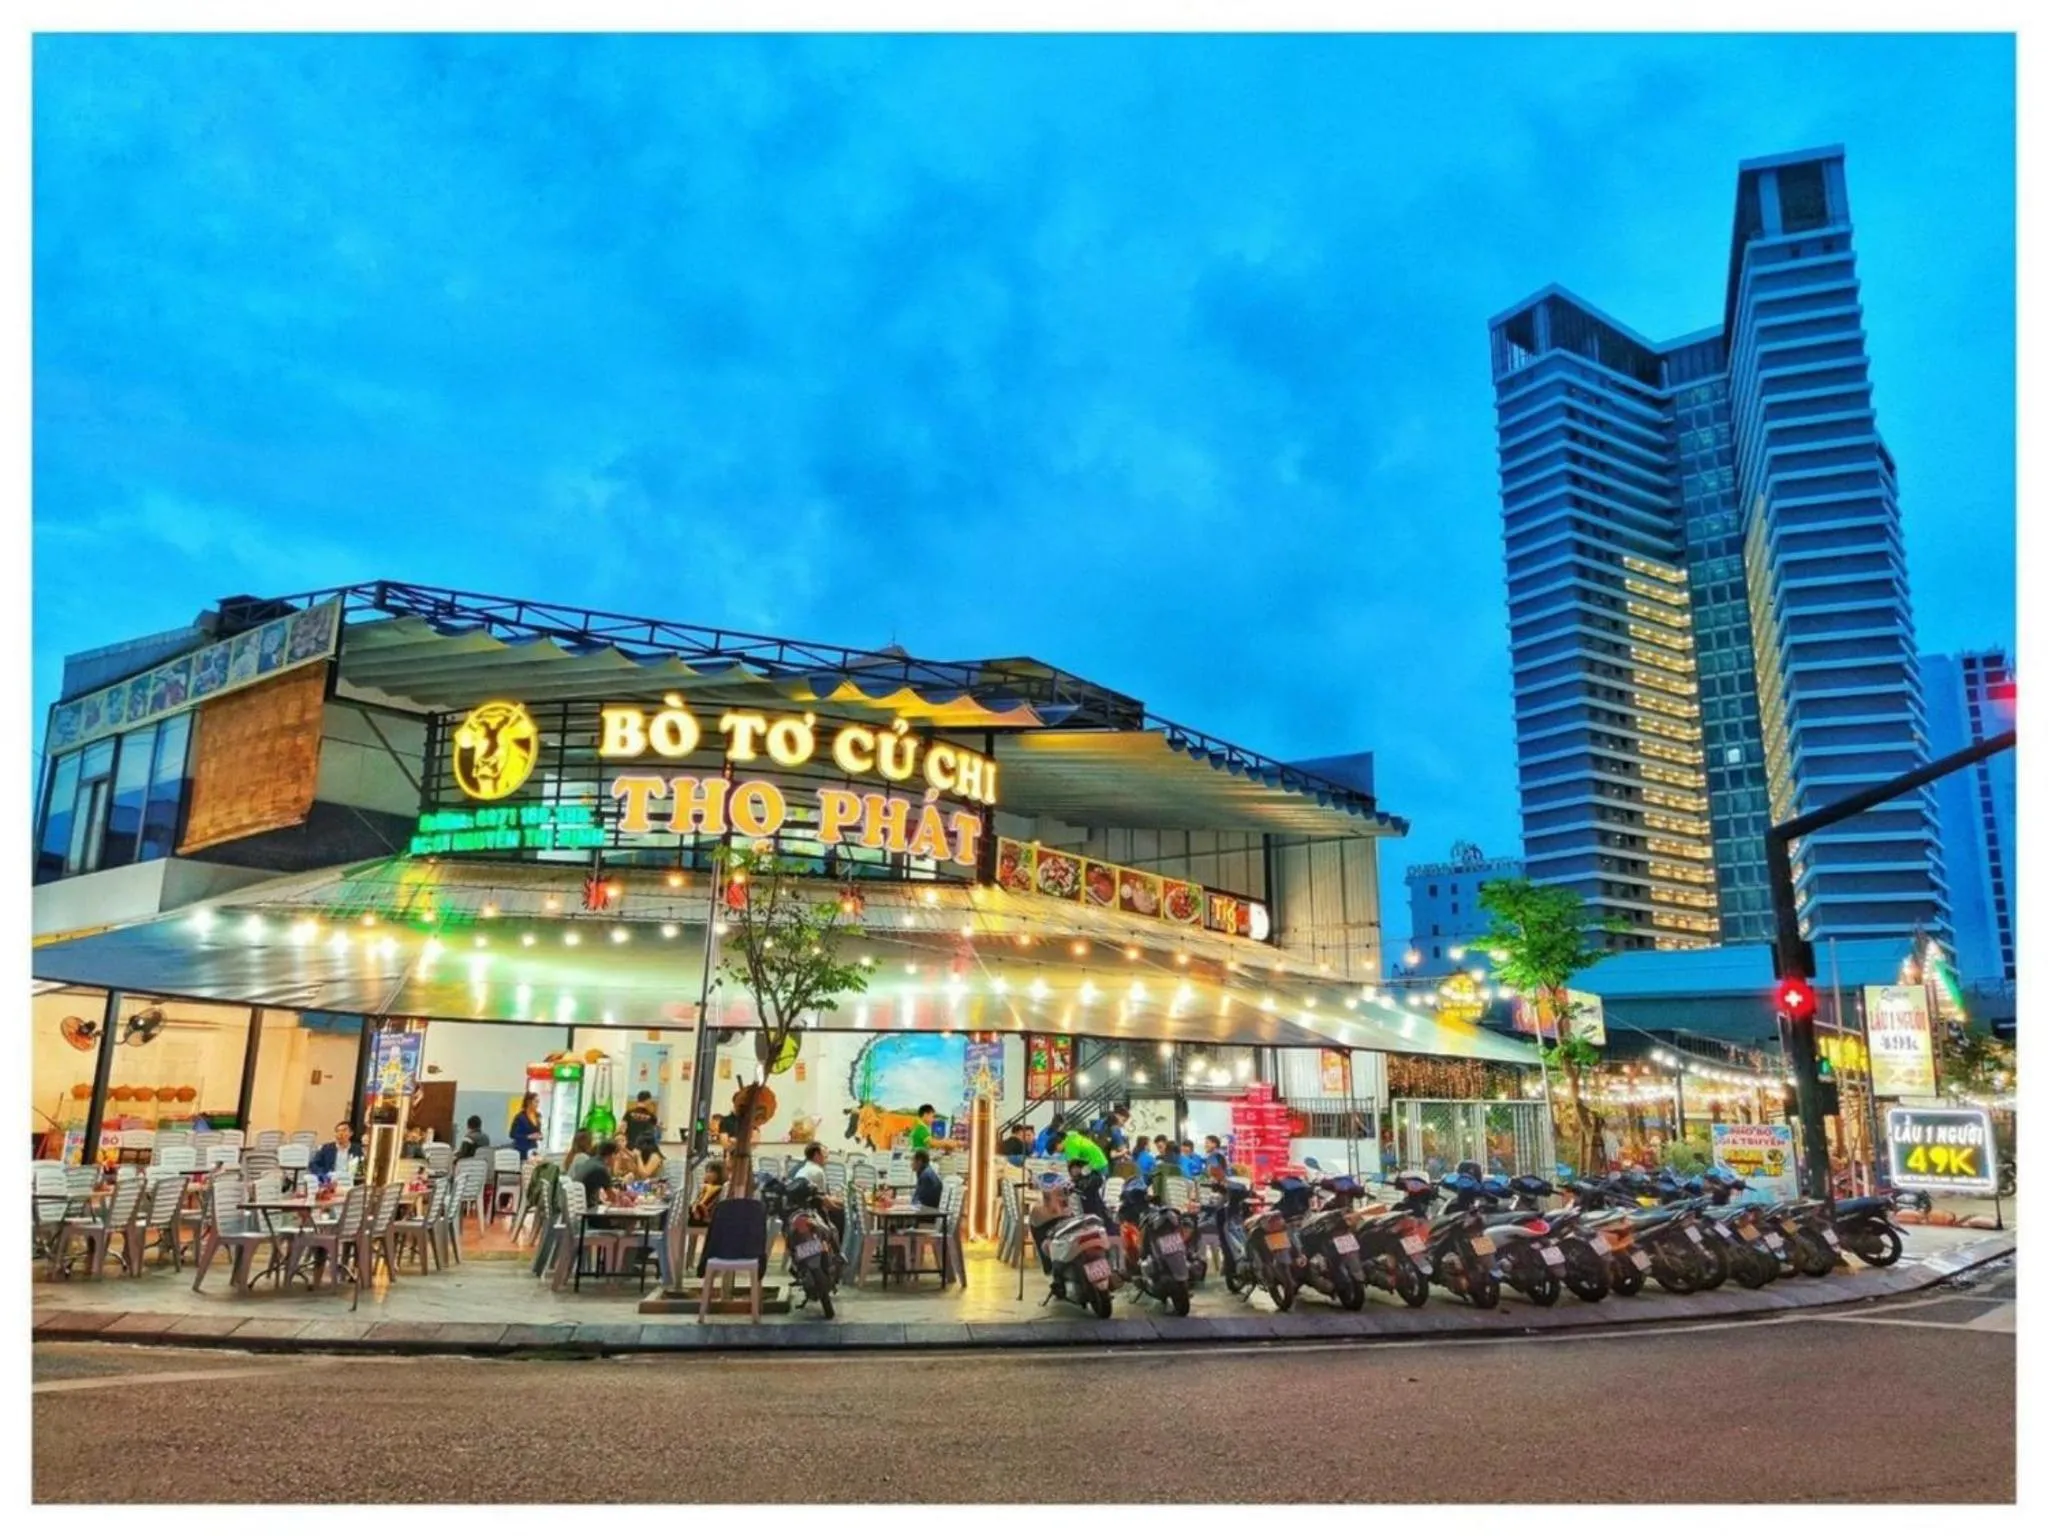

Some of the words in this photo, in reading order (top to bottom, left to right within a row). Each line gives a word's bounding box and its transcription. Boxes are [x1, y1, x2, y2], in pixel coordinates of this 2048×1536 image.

[600, 693, 700, 758] BÒ
[719, 711, 816, 766] TƠ
[833, 718, 918, 781] CỦ
[924, 742, 997, 805] CHI
[817, 787, 982, 866] PHÁT
[1894, 1114, 1922, 1144] LẨU
[1926, 1125, 1933, 1144] 1
[1936, 1122, 1983, 1145] NGƯỜI
[1906, 1145, 1976, 1176] 49K
